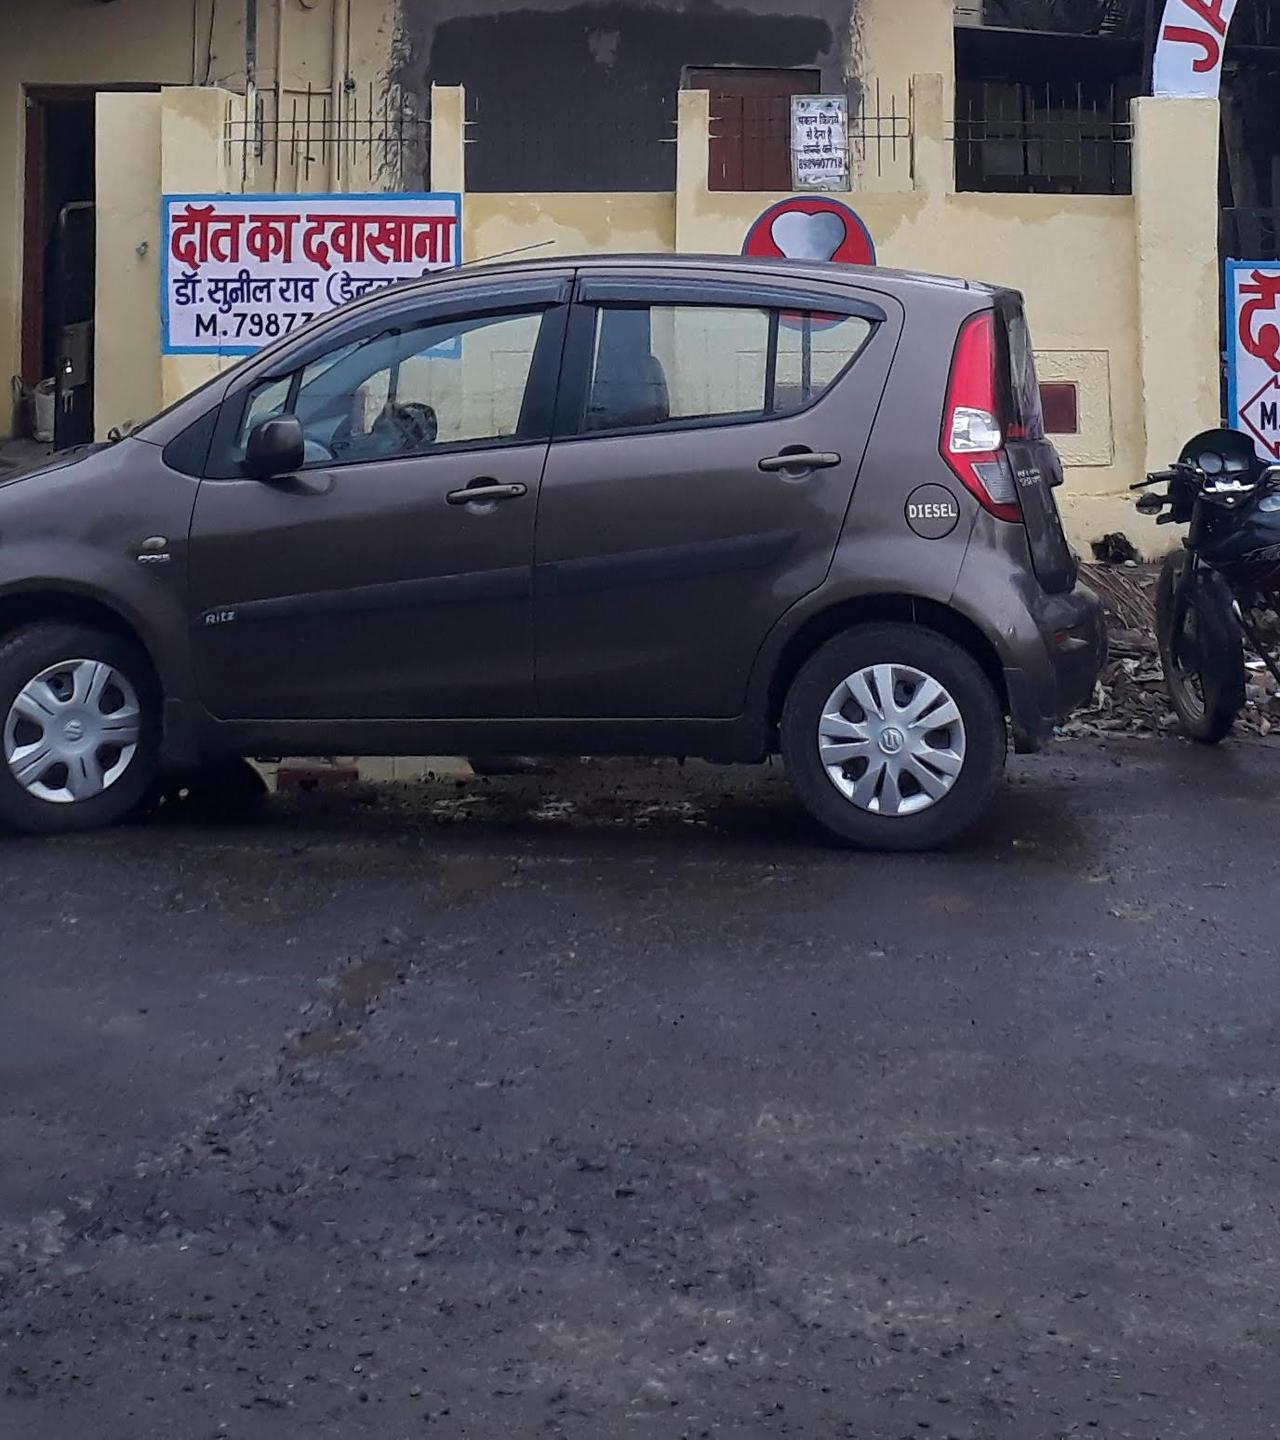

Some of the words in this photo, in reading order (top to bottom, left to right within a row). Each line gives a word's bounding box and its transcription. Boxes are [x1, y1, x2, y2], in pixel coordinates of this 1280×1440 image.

[247, 215, 300, 264] का
[303, 215, 457, 271] दवाखाना
[279, 277, 319, 302] राव
[908, 503, 956, 518] DIESEL
